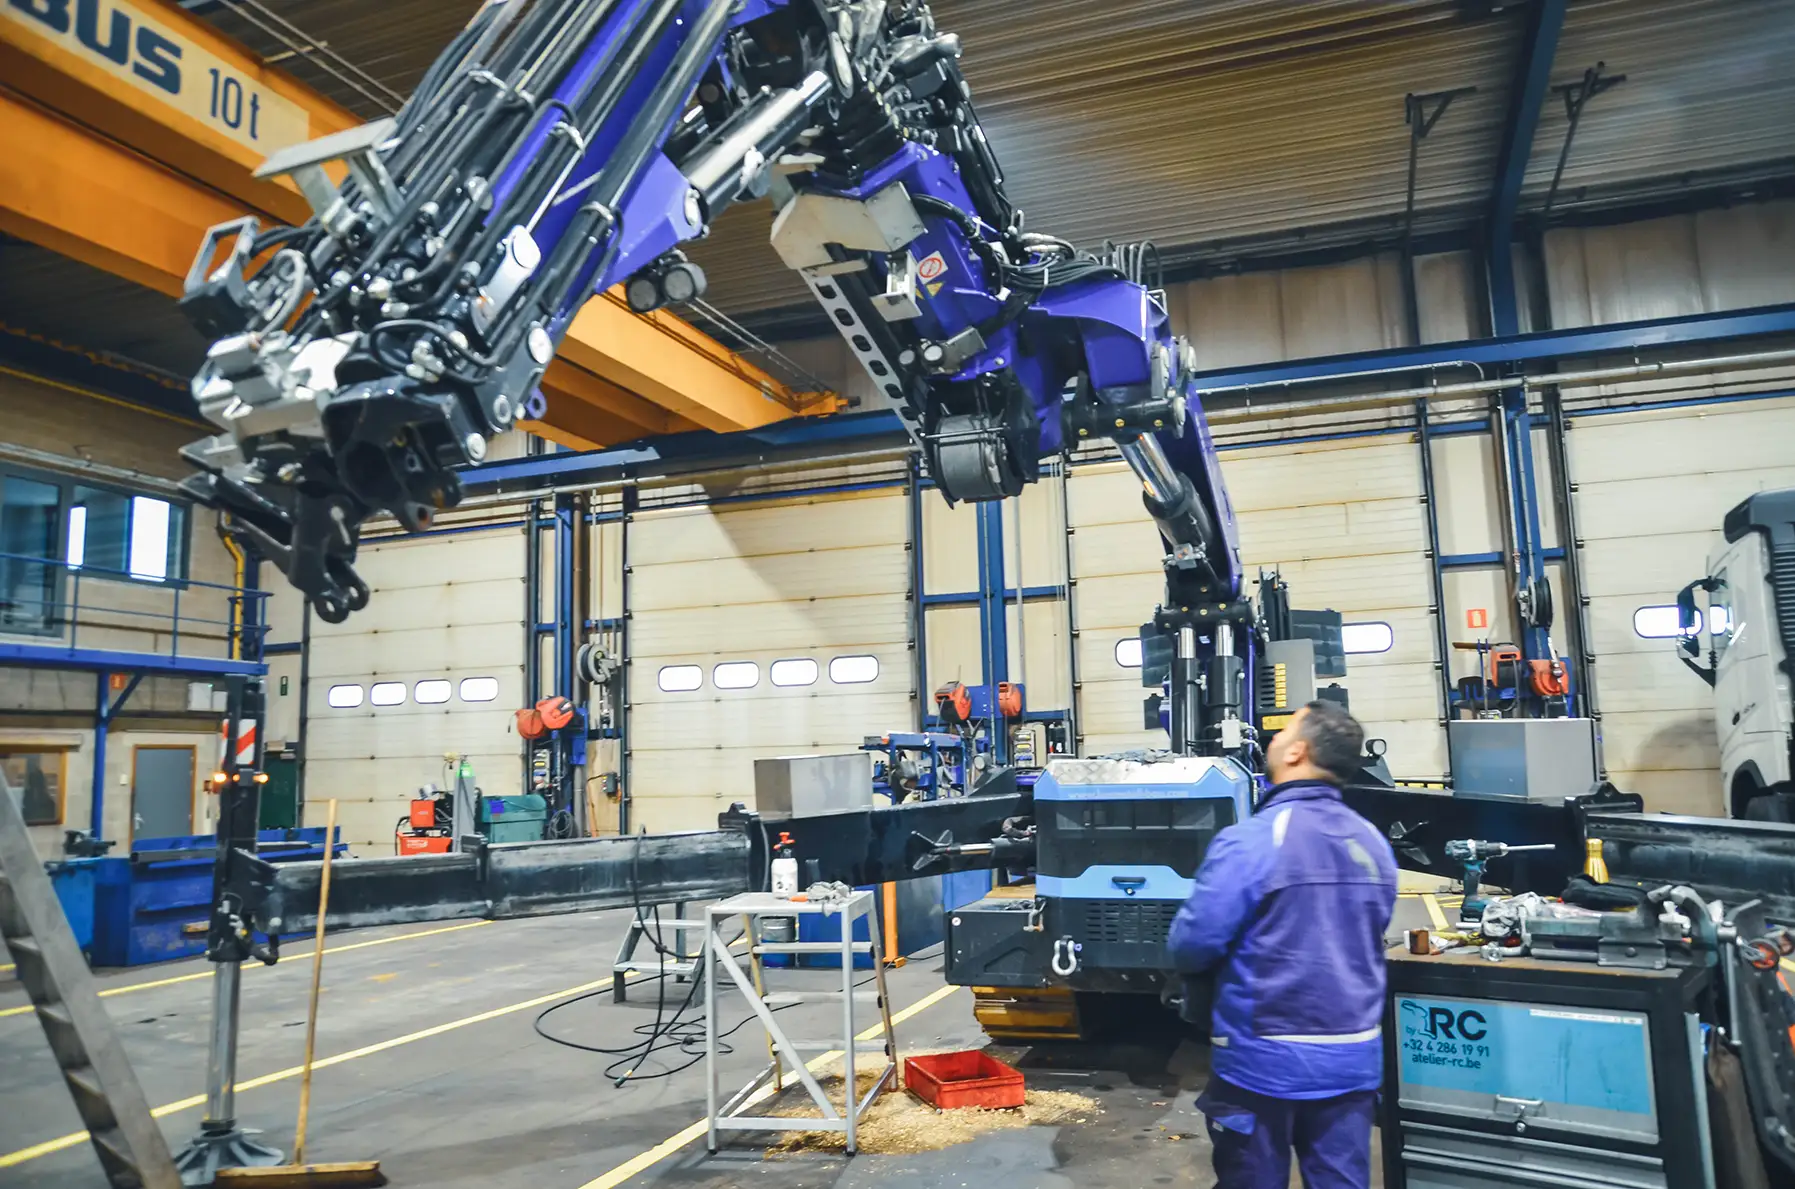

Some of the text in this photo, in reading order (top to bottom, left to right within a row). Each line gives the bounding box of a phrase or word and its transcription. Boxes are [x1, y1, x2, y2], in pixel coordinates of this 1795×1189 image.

[209, 68, 242, 129] 10
[249, 92, 260, 140] t
[1429, 1007, 1487, 1041] RC
[1403, 1039, 1489, 1057] +32 4 286 19 91
[1412, 1053, 1481, 1069] atelier-rc.be
